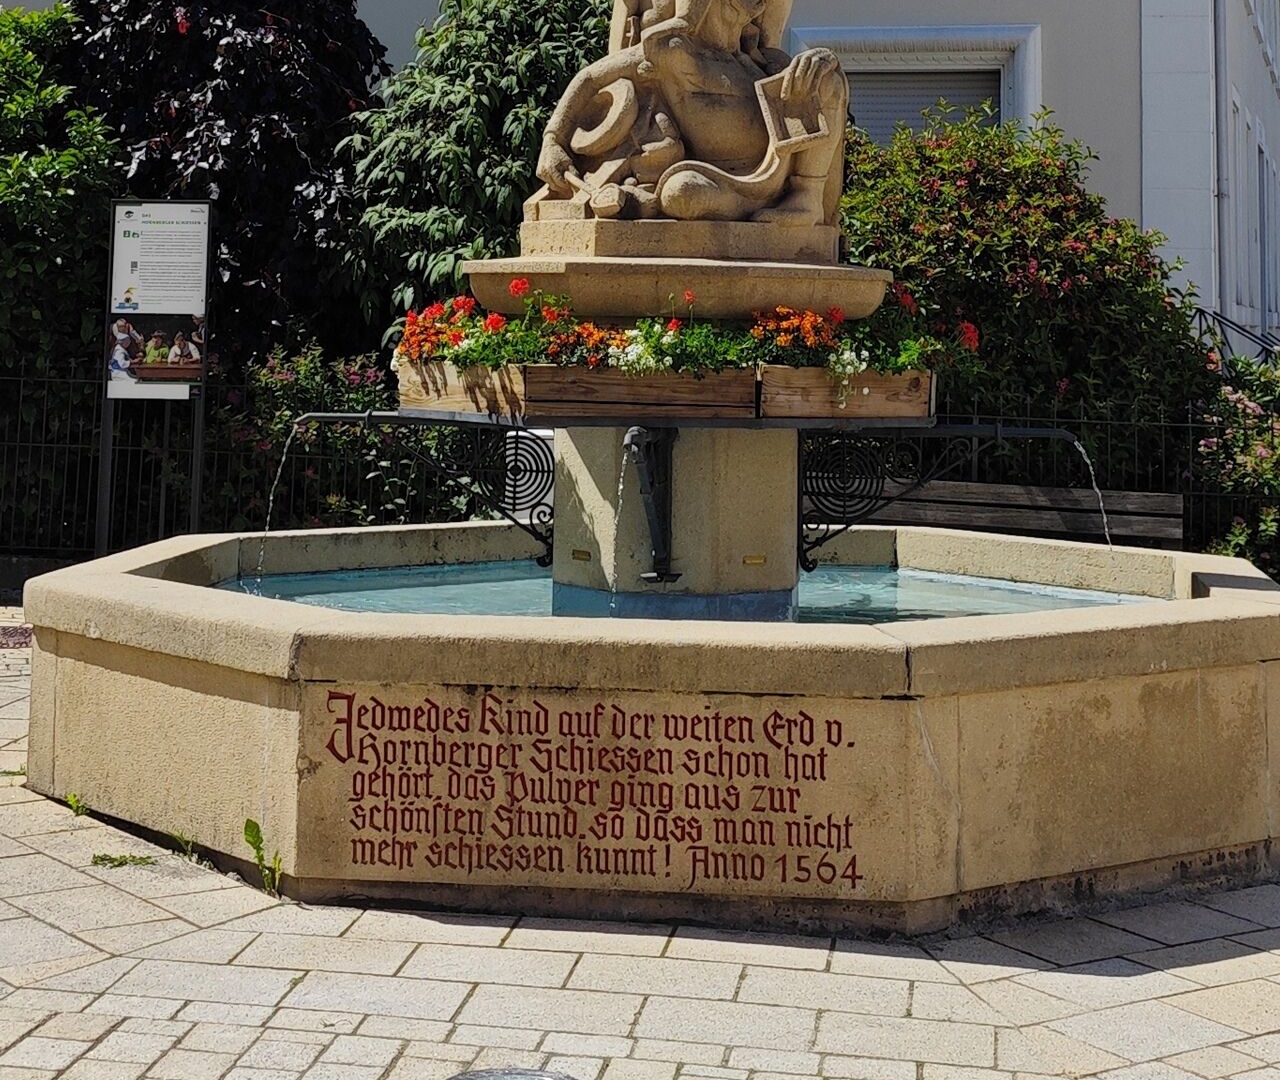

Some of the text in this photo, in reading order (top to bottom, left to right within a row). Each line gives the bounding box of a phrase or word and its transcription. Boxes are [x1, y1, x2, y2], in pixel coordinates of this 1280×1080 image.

[325, 690, 471, 764] Jedwedes
[479, 693, 551, 736] Kind
[558, 702, 606, 738] auf
[611, 703, 656, 741] der
[662, 705, 755, 745] weiten
[762, 709, 815, 750] Erd
[357, 732, 829, 783] Hornberger Schiessen schon hat
[447, 766, 496, 802] das
[503, 770, 601, 807] Pulver
[607, 774, 674, 814] ging
[683, 782, 741, 812] aus
[750, 784, 802, 814] zur
[588, 811, 625, 841] so
[635, 807, 703, 843] dass
[712, 817, 776, 847] man
[783, 813, 854, 853] nicht
[350, 834, 418, 870] mehr
[424, 835, 565, 875] schiessen
[683, 845, 766, 890] Anno
[773, 851, 864, 890] 1564
